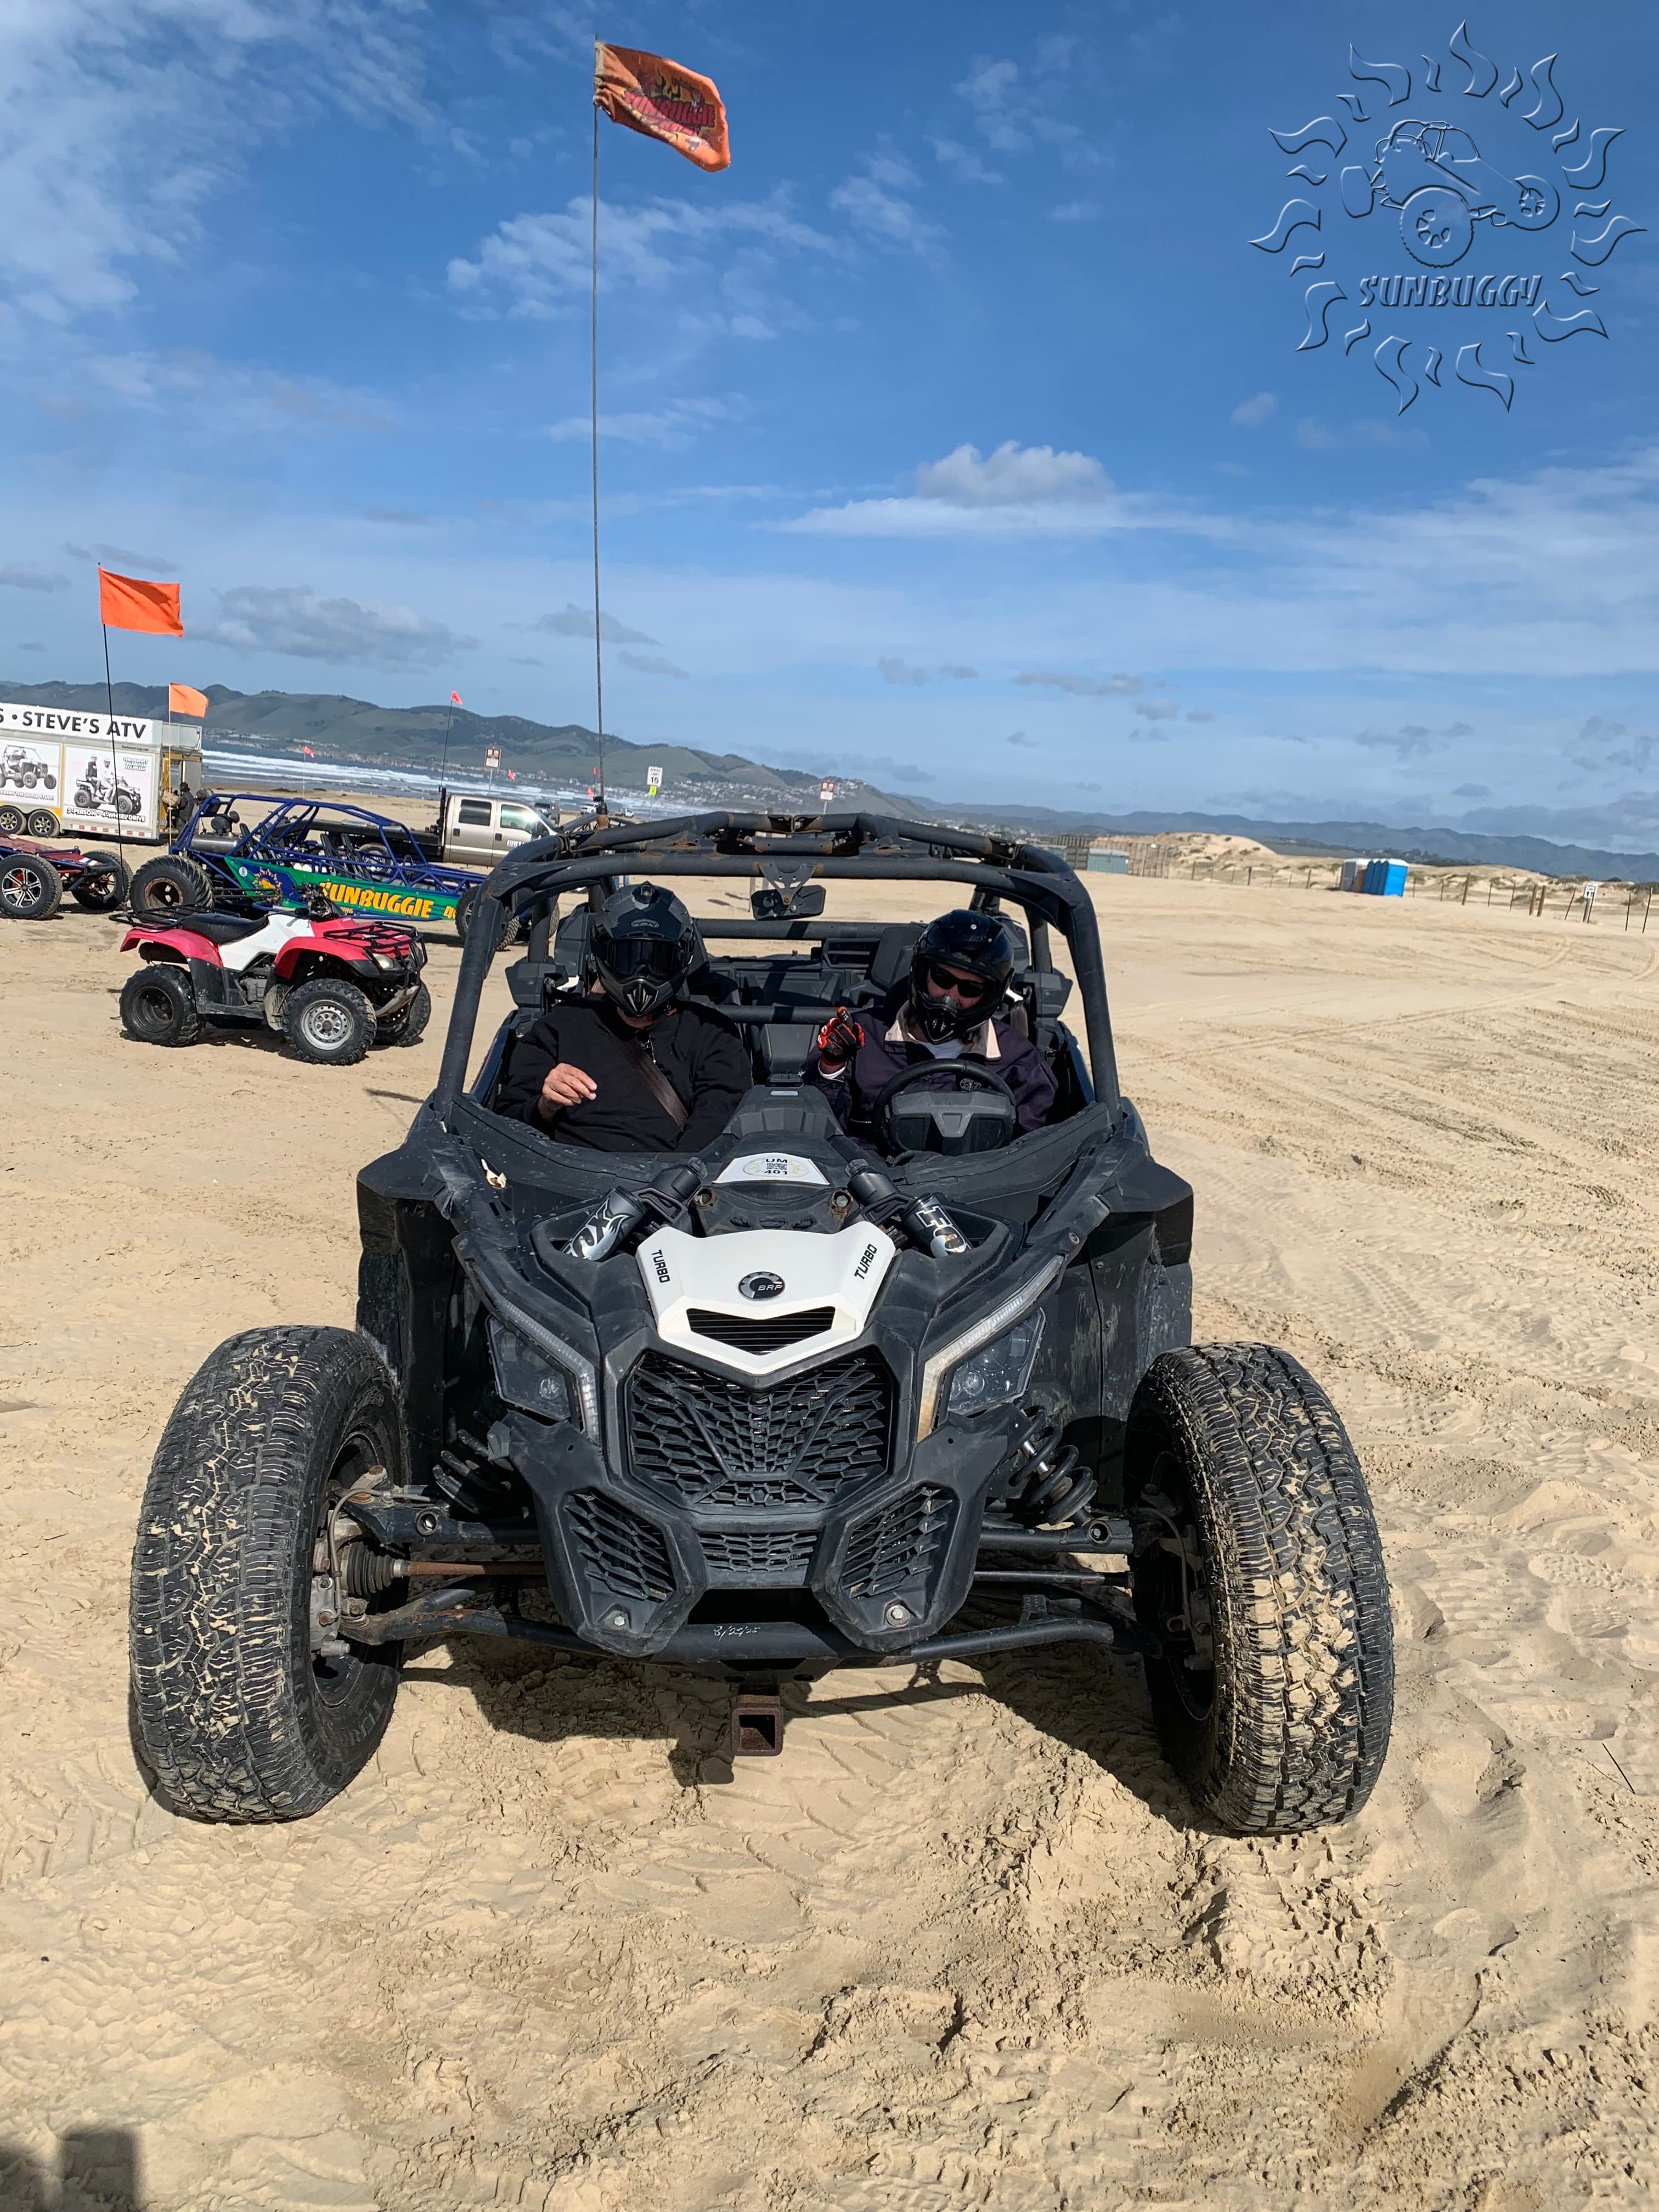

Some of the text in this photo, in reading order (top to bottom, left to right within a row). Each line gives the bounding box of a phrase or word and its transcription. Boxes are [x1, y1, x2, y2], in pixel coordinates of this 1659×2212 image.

[22, 710, 100, 734] STEVE'S
[106, 721, 146, 738] ATV
[66, 808, 97, 817] 2-PERSON
[127, 814, 146, 822] DRIVE
[651, 1249, 670, 1284] TURBO
[854, 1243, 878, 1281] TURBO
